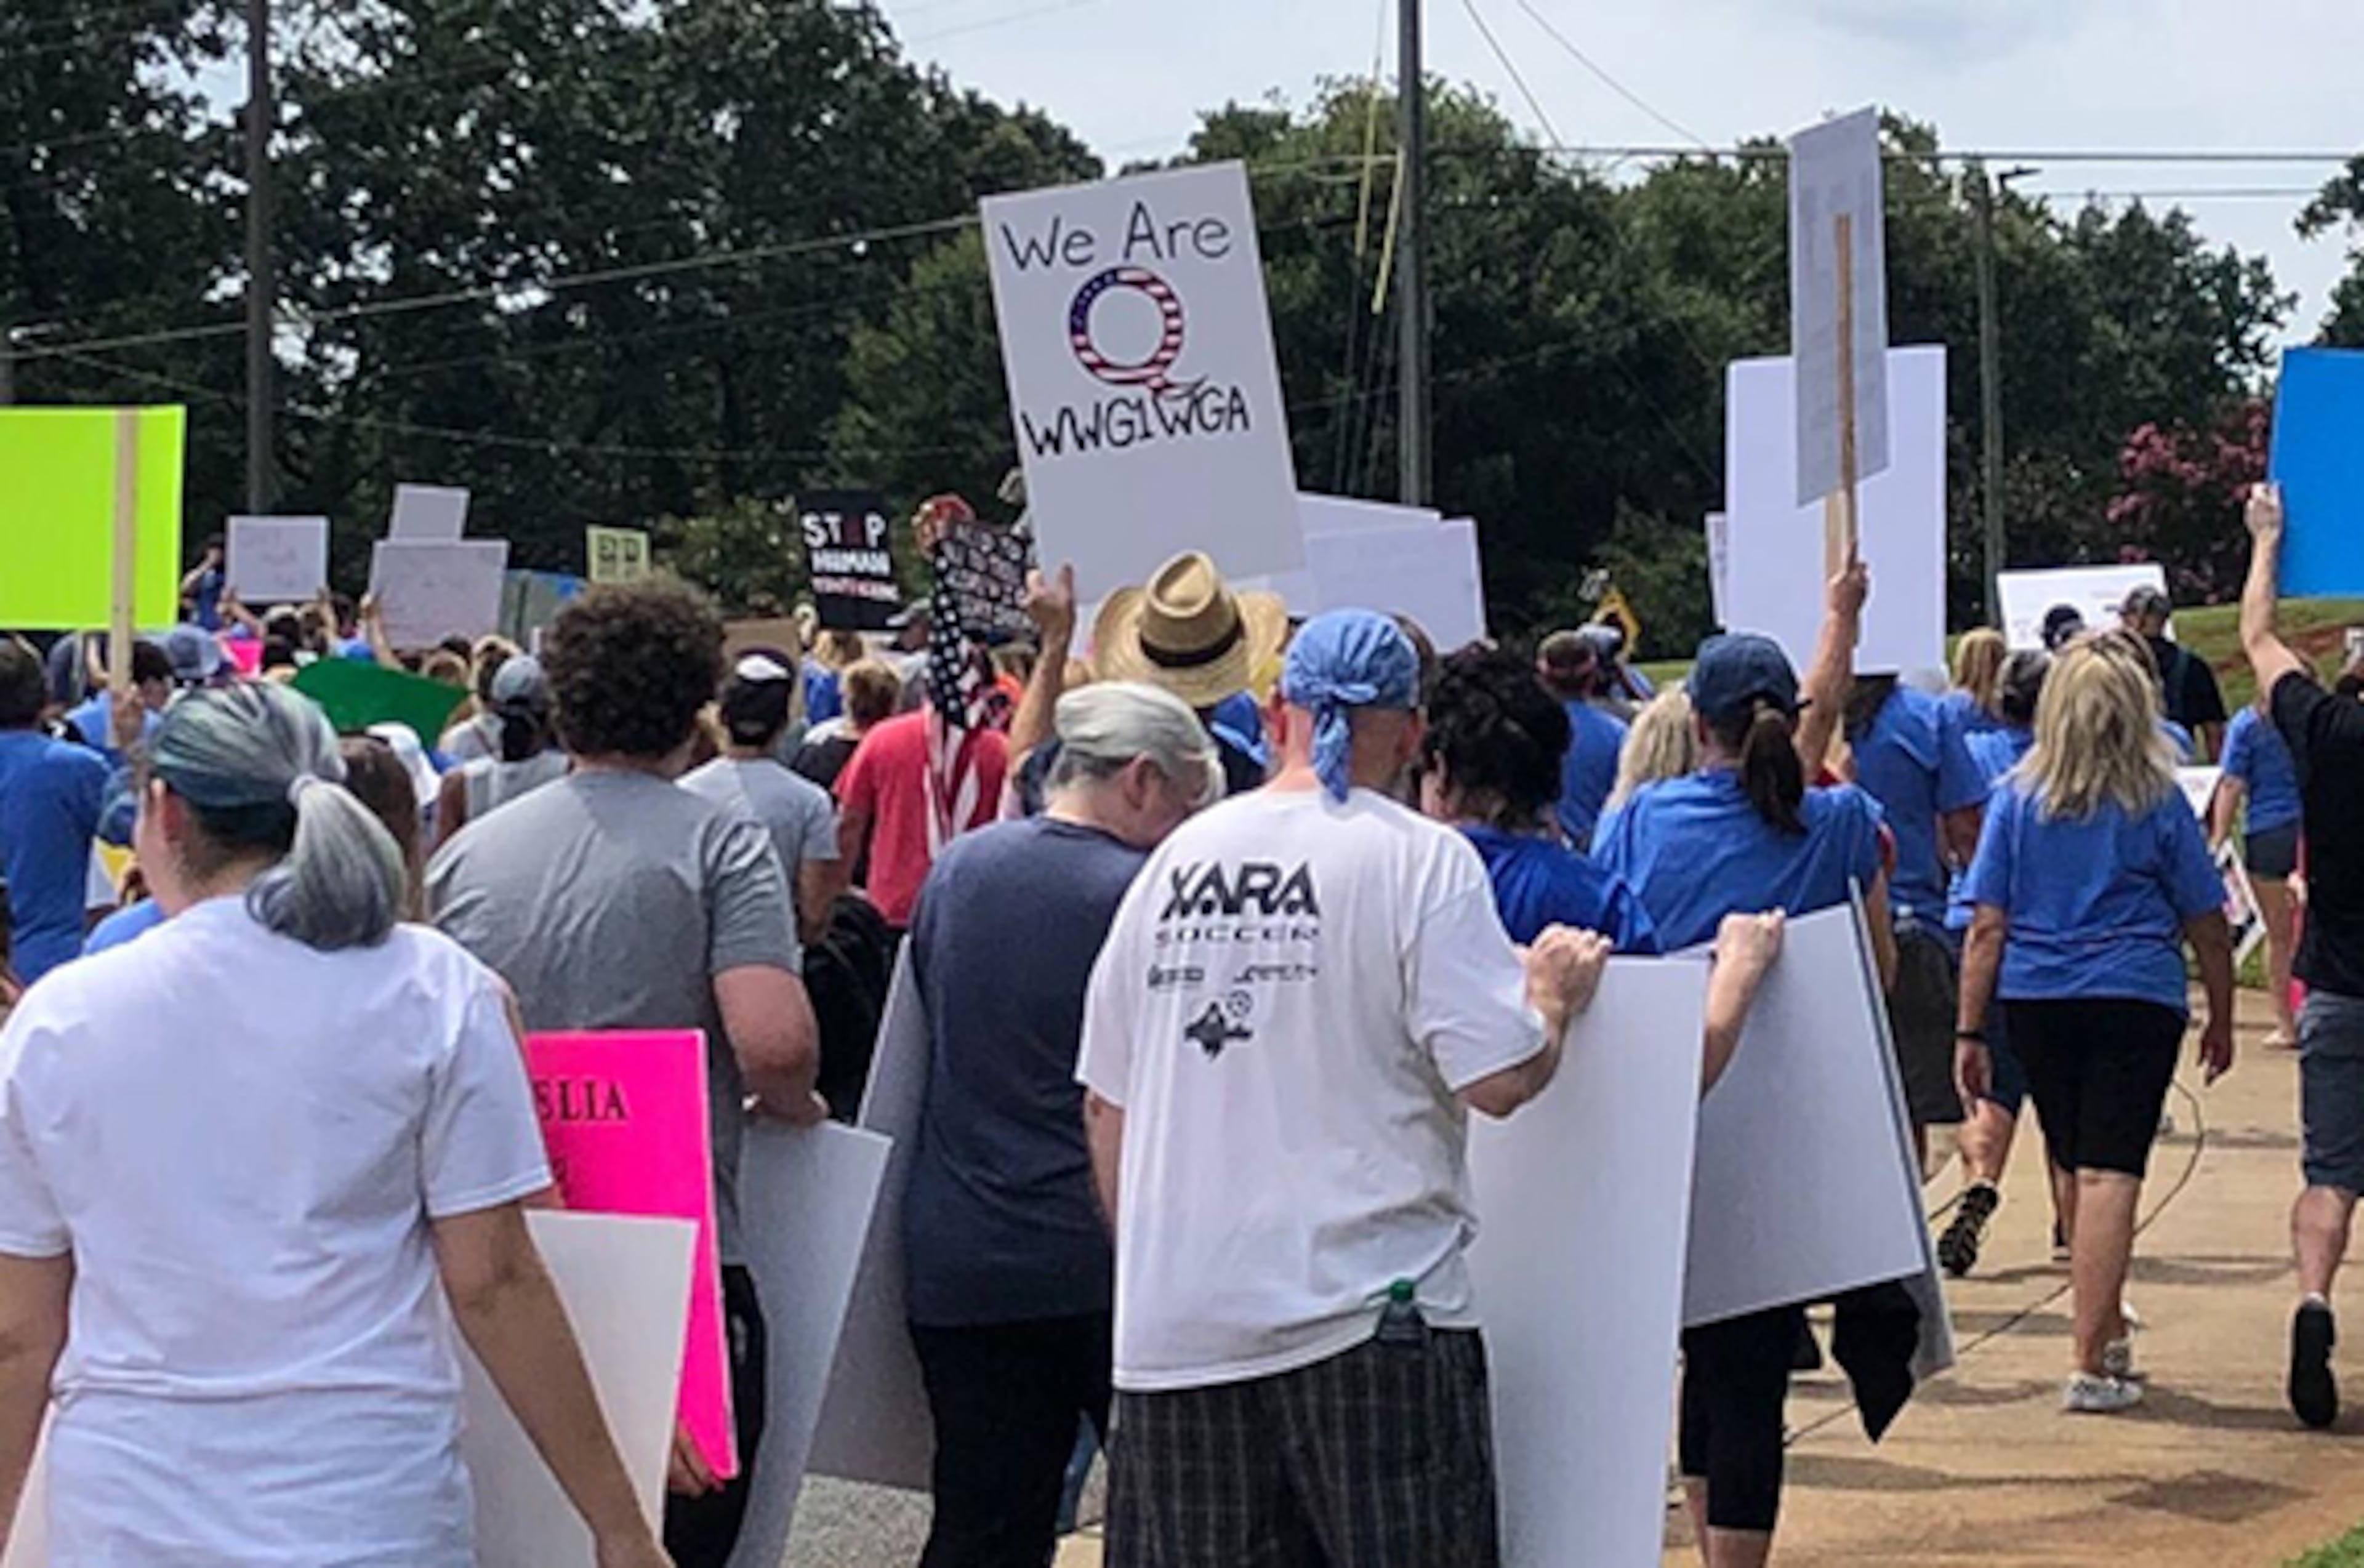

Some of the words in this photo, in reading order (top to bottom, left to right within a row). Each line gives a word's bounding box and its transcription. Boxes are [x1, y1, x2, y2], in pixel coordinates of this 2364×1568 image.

[1000, 215, 1096, 270] We
[1124, 201, 1231, 260] Are
[1070, 265, 1207, 401] Q
[1160, 861, 1321, 922] XARA
